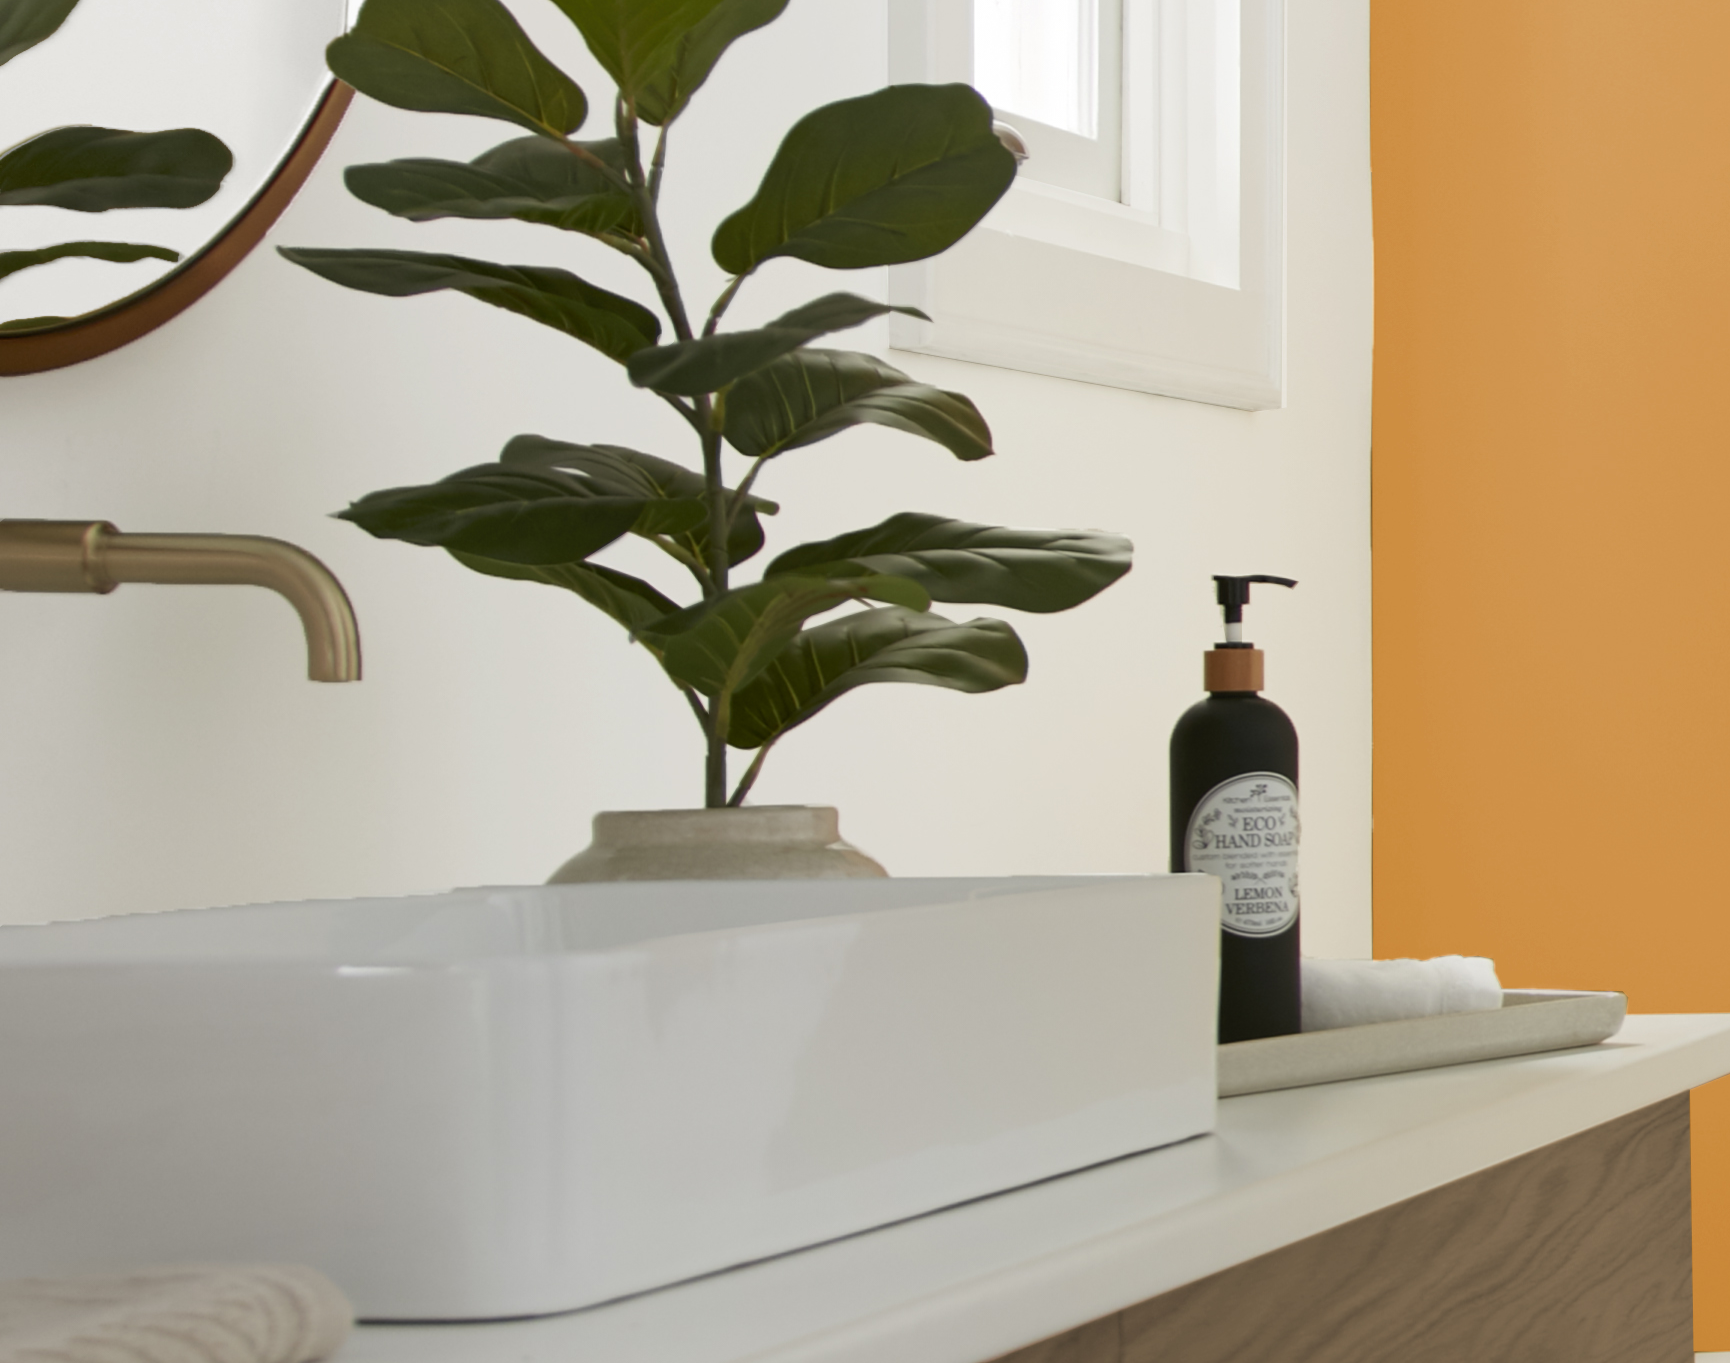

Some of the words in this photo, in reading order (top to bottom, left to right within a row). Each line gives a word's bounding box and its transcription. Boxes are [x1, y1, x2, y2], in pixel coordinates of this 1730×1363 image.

[1242, 816, 1276, 832] ECO
[1215, 833, 1261, 850] HAND
[1264, 831, 1295, 848] SOAP
[1234, 886, 1283, 901] LEMON
[1225, 901, 1289, 915] VERBENA
